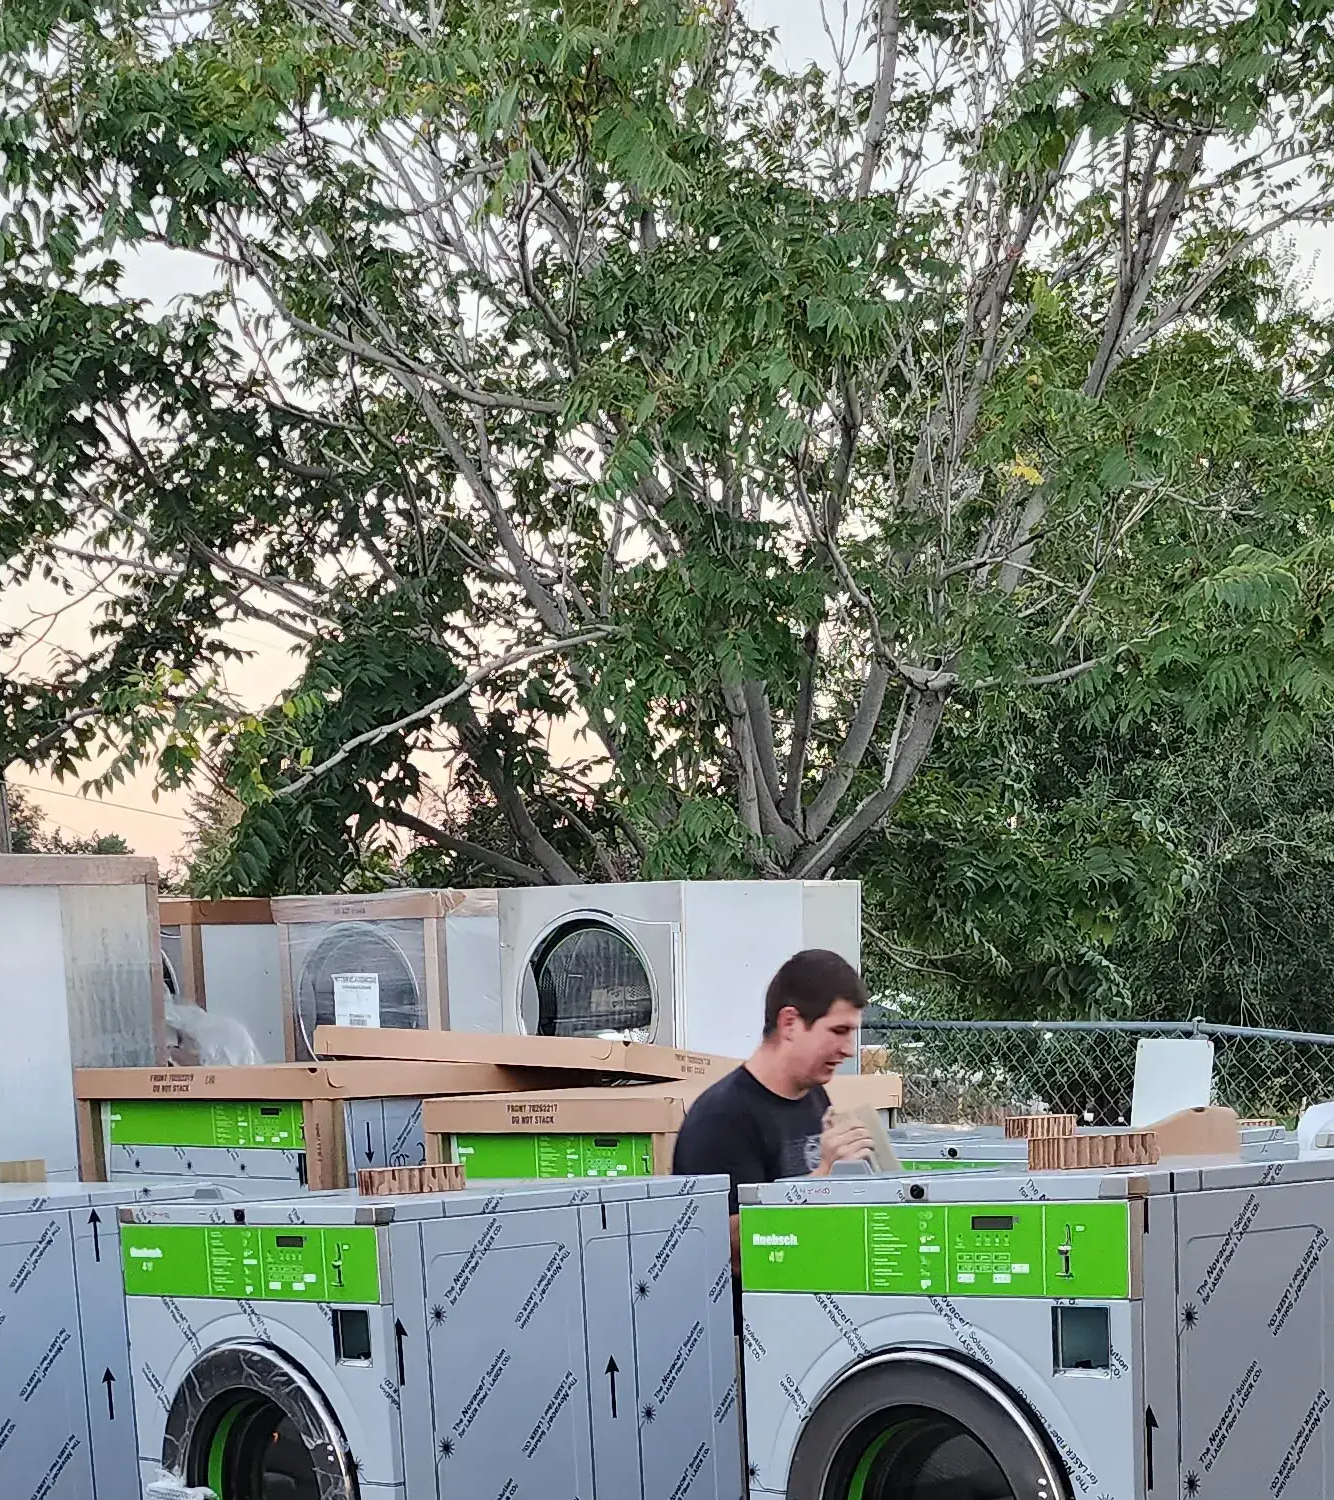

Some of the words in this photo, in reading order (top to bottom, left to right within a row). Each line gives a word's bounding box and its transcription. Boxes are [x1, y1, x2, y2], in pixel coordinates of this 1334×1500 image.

[507, 1105, 527, 1113] FRONT
[511, 1116, 520, 1125] DO
[521, 1116, 533, 1125] NOT
[534, 1116, 554, 1125] STACK
[941, 1313, 958, 1332] Fiber
[967, 1330, 996, 1366] Solution
[1048, 1428, 1069, 1449] Fiber
[1065, 1447, 1089, 1474] LASER
[1074, 1474, 1091, 1494] The
[1085, 1471, 1100, 1486] for
